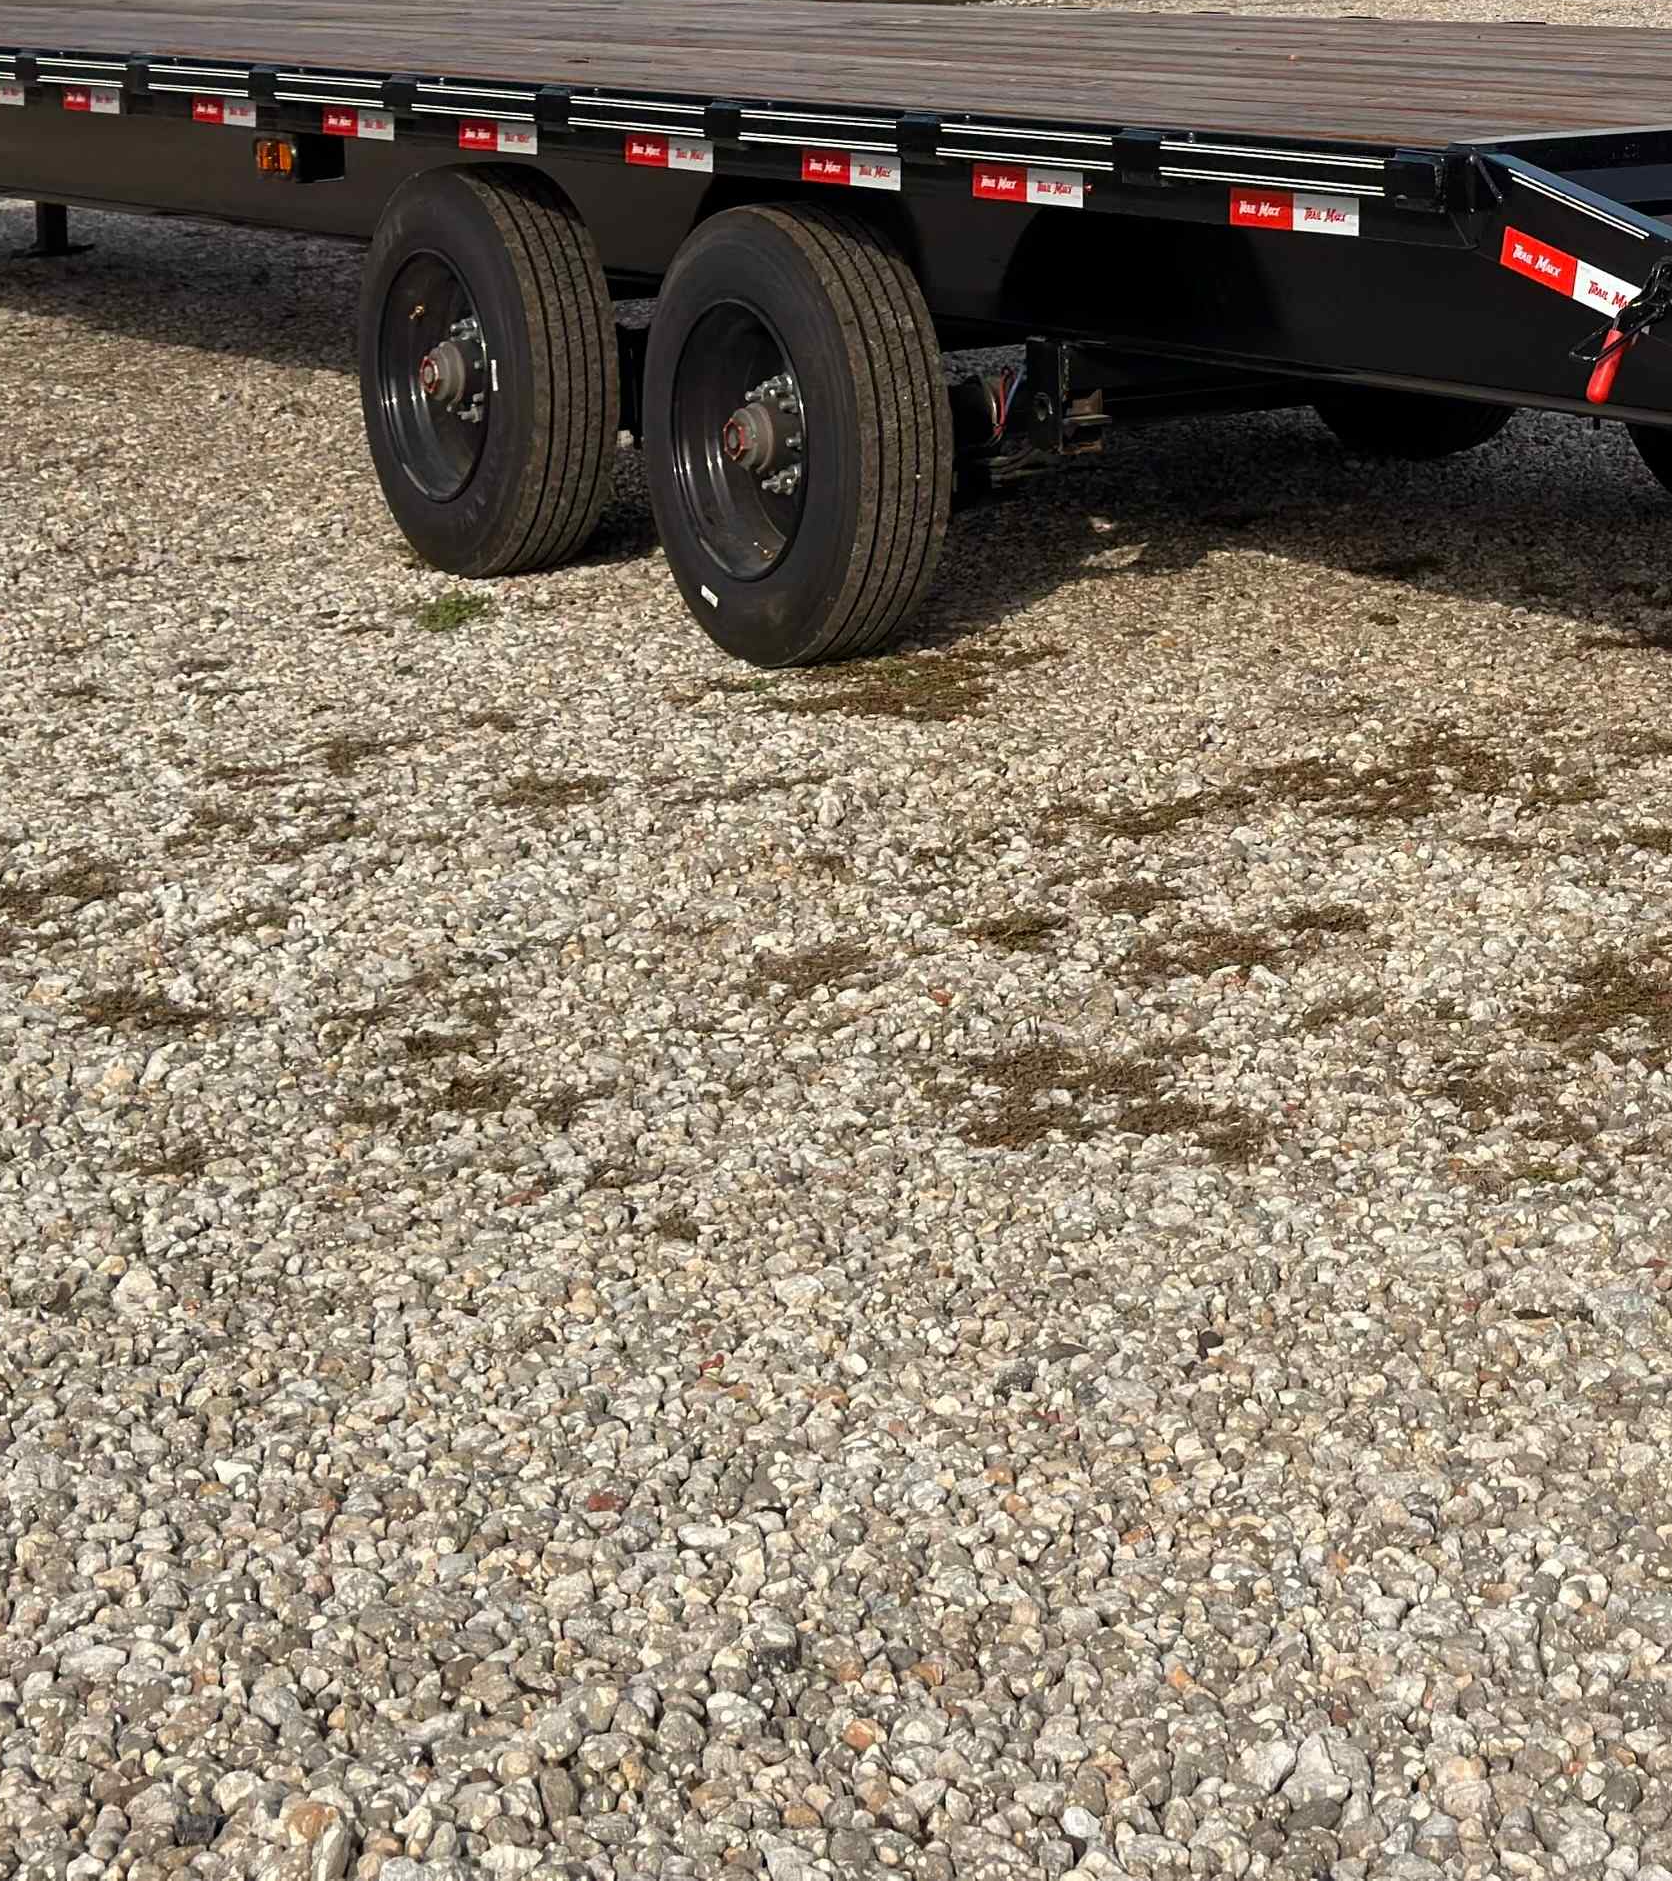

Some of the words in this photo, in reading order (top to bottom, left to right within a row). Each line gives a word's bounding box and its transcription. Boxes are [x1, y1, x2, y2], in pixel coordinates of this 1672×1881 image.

[1512, 243, 1533, 265] TRAIL
[1534, 254, 1562, 277] MAXX
[1587, 280, 1609, 301] TRAIL
[1611, 291, 1630, 309] MA
